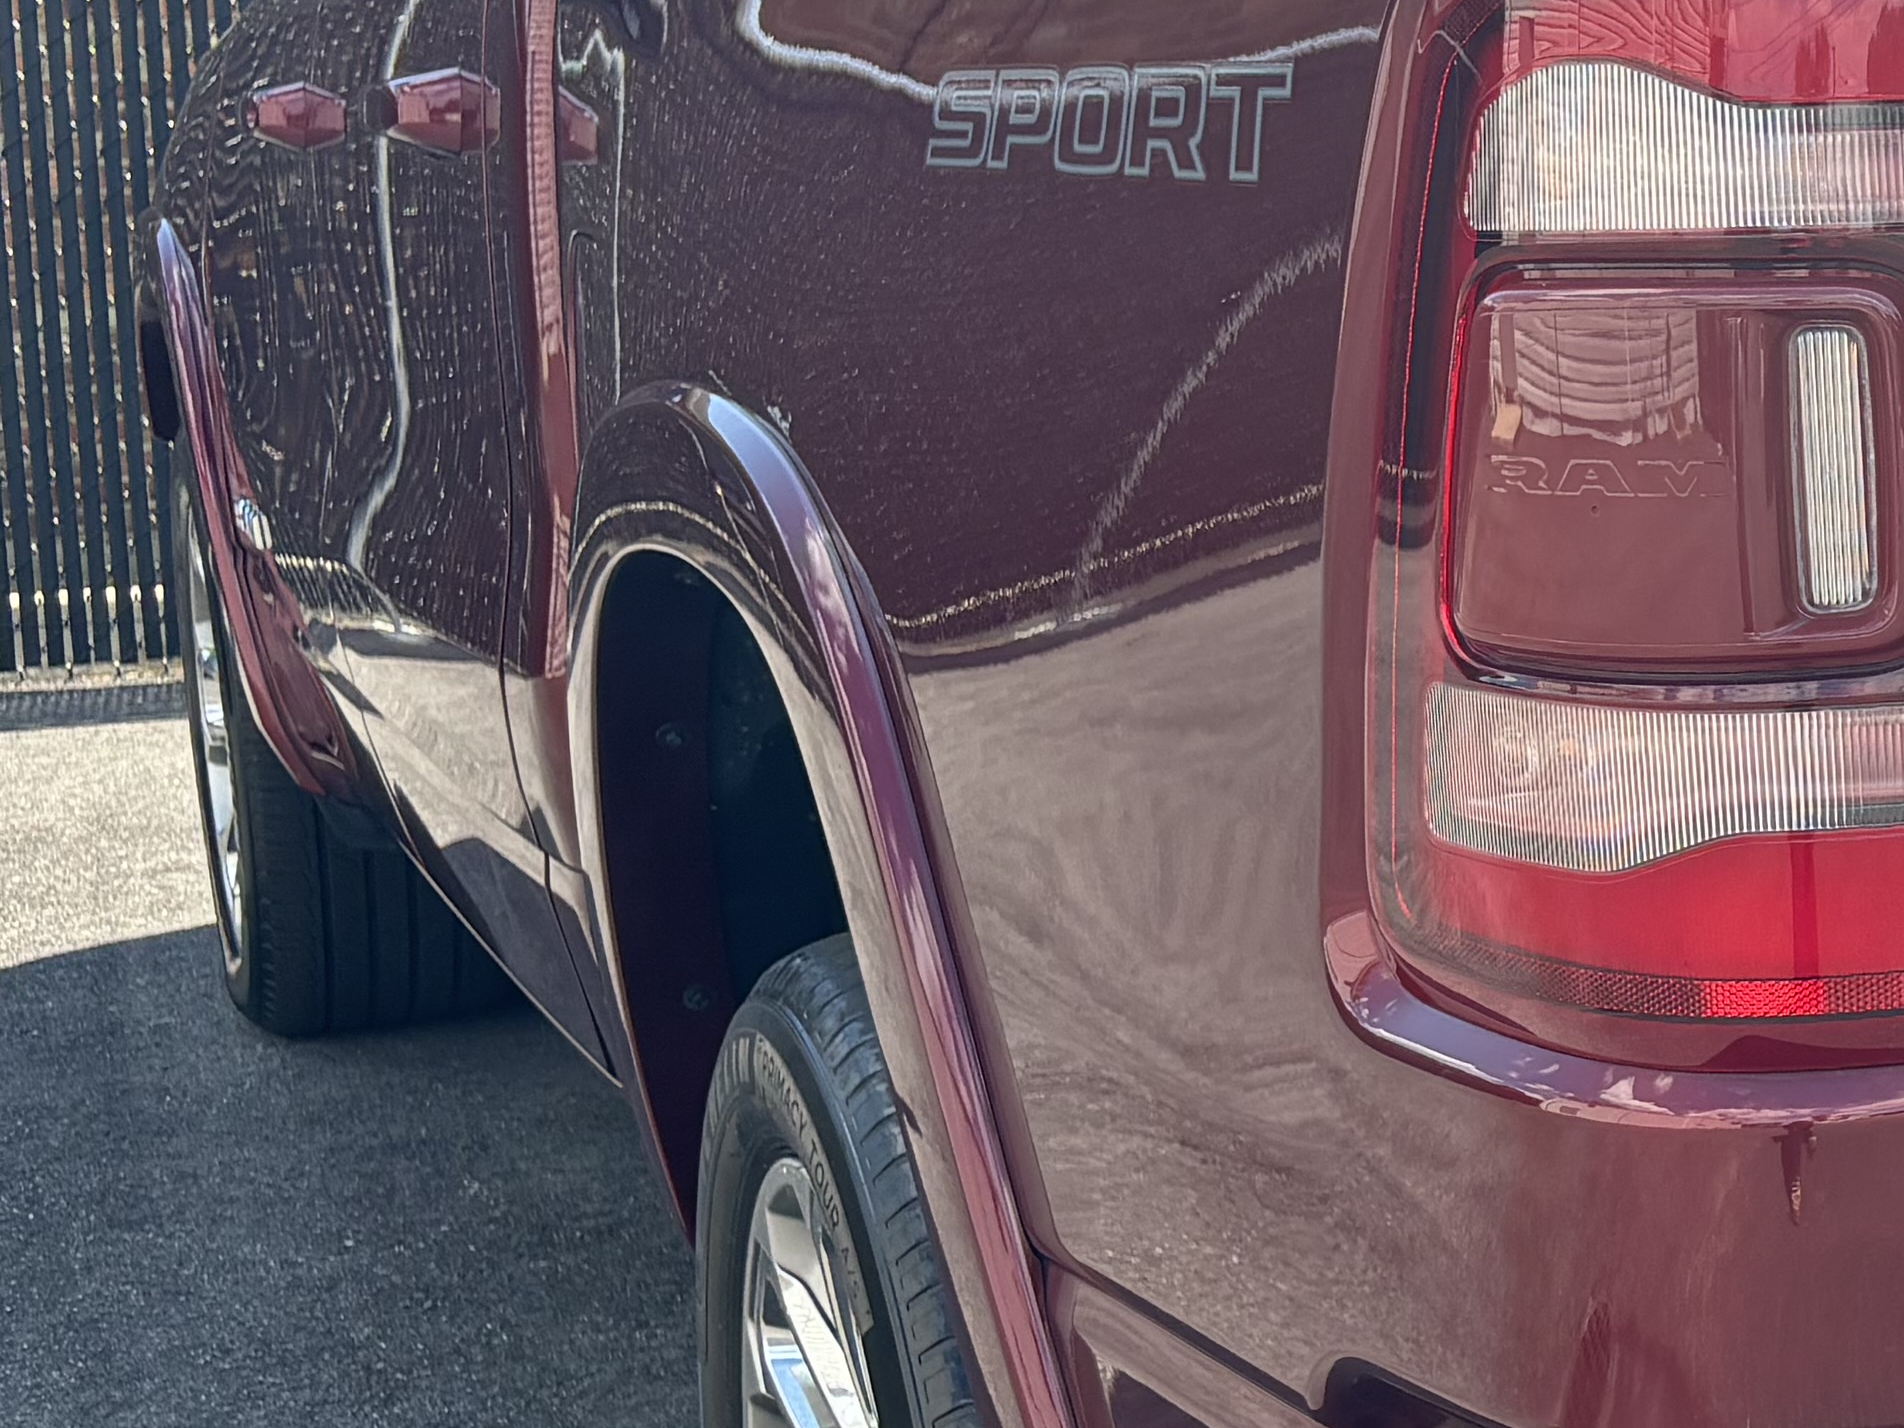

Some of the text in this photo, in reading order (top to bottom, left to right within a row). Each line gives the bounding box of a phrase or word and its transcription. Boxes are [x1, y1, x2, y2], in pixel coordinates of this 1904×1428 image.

[926, 61, 1295, 184] SPORT
[1487, 455, 1730, 497] RAM
[761, 1049, 808, 1139] PRIMACY
[809, 1138, 840, 1228] TOUR
